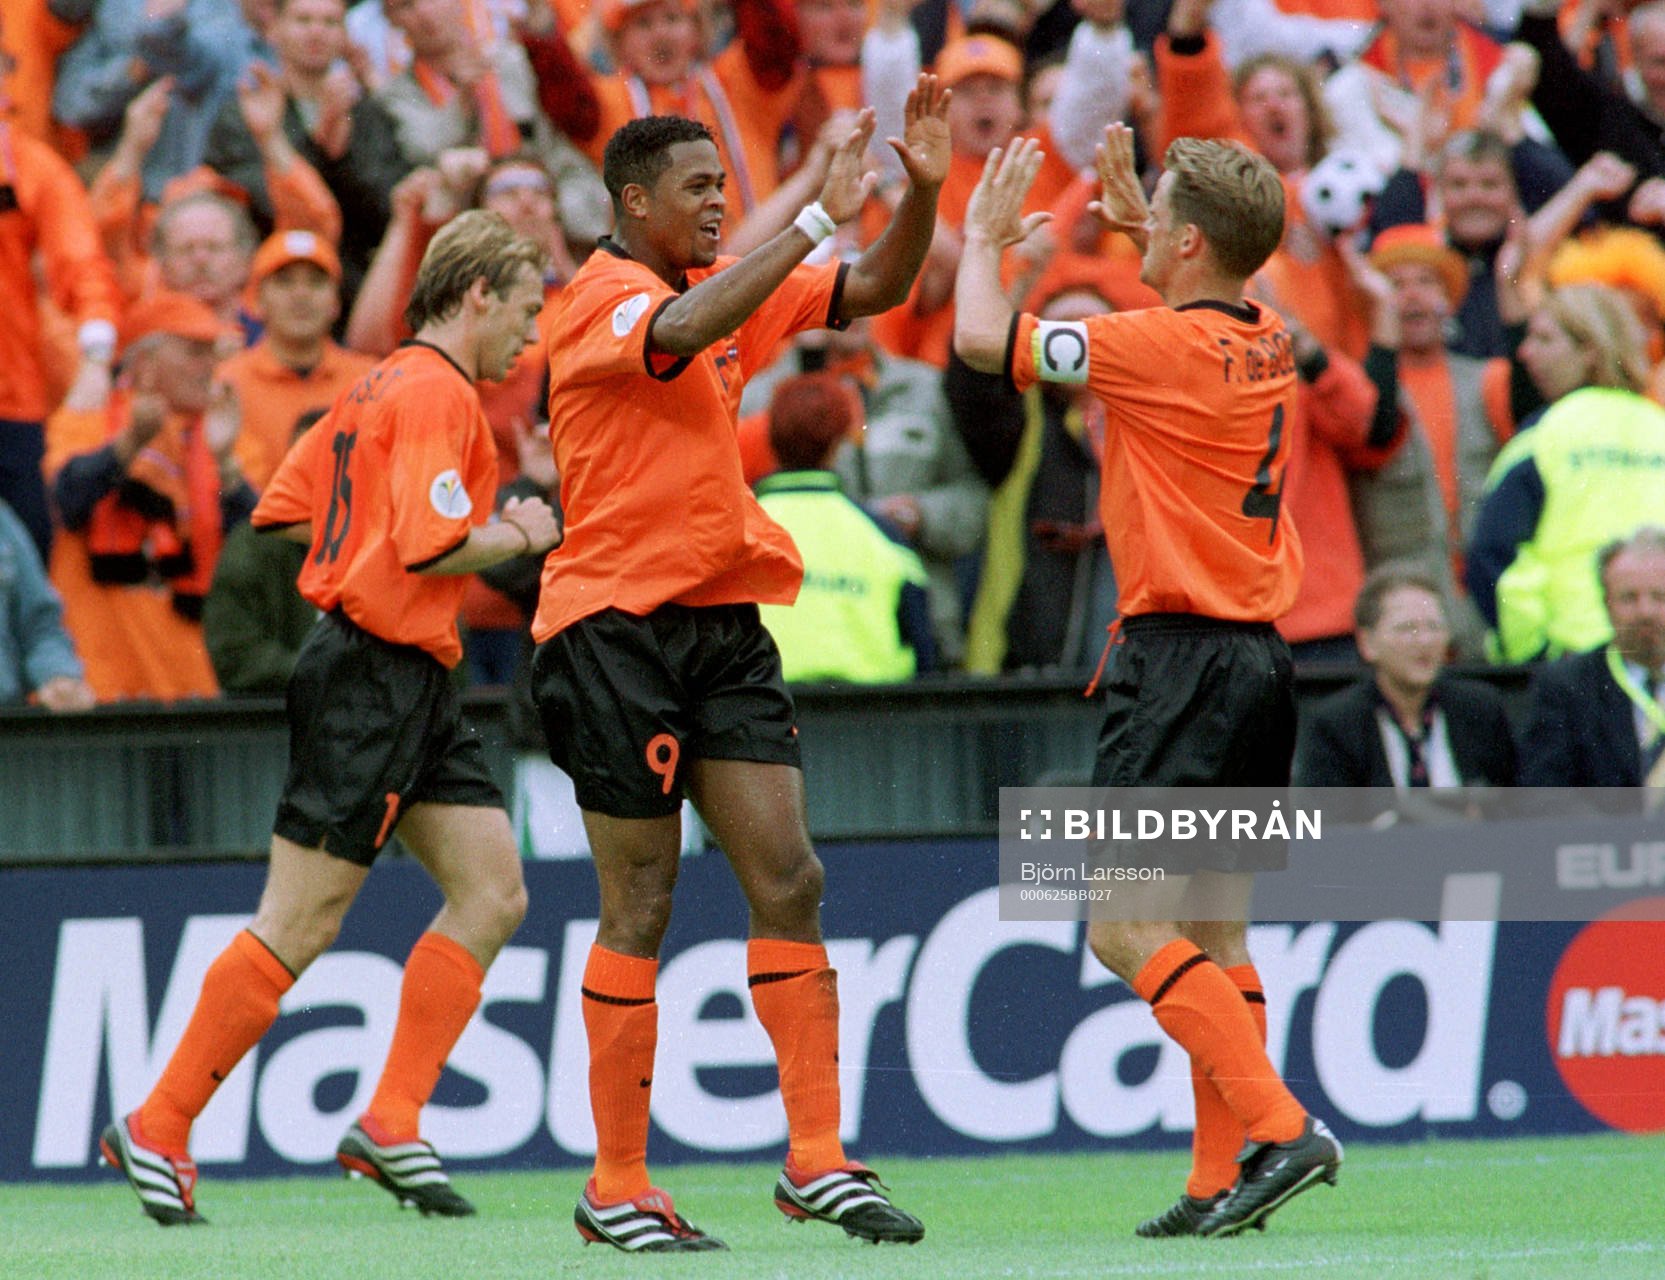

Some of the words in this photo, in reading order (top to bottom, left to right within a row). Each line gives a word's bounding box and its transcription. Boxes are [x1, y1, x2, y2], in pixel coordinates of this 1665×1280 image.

[1044, 327, 1086, 372] C
[314, 431, 358, 565] 15
[1241, 402, 1287, 546] 4
[646, 733, 680, 794] 9
